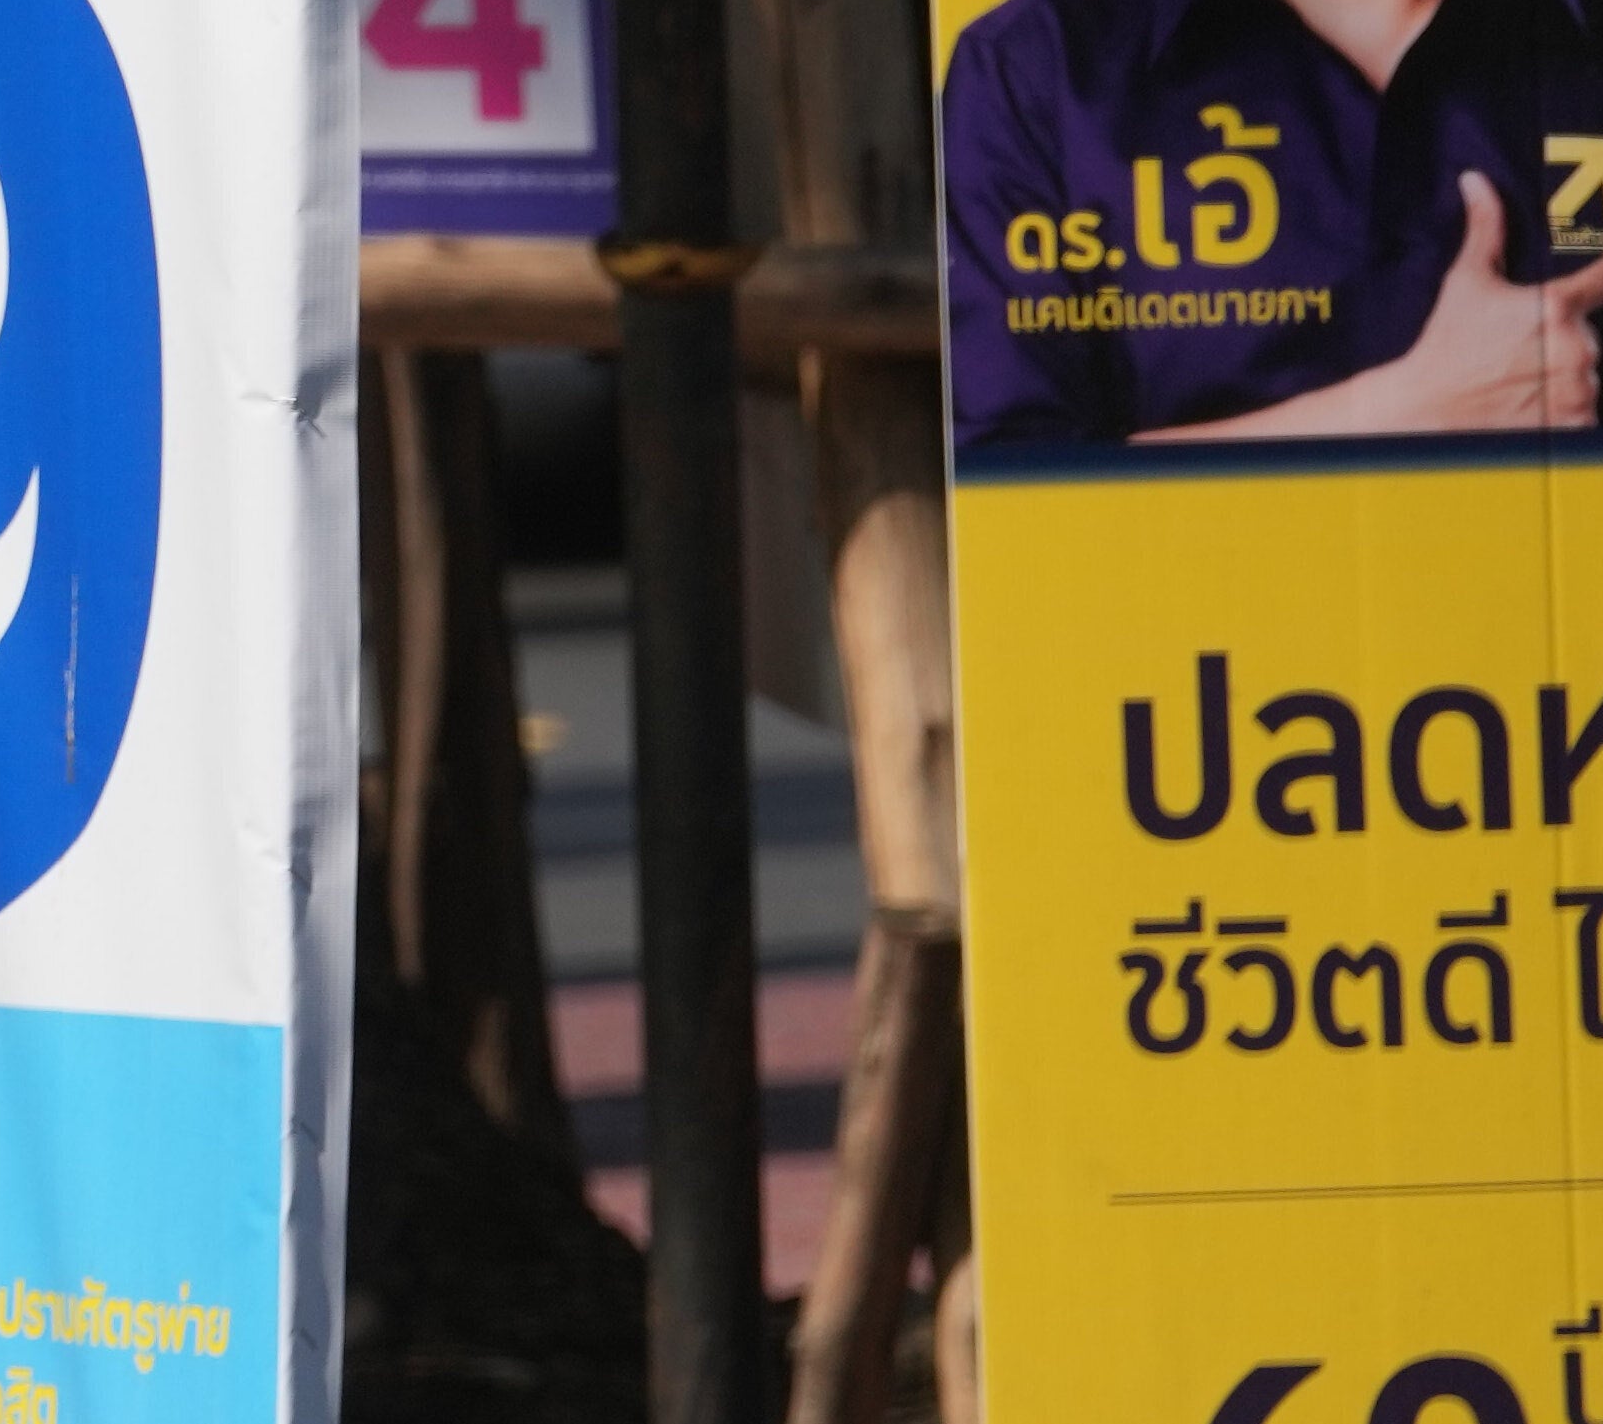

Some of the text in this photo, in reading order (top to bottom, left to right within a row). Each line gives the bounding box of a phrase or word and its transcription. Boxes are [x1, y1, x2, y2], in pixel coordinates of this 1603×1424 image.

[1004, 102, 1282, 274] ดร.เอ้
[1006, 287, 1333, 334] แคนดิเดตนายกฯ
[1120, 892, 1517, 1054] ชีวิตดี
